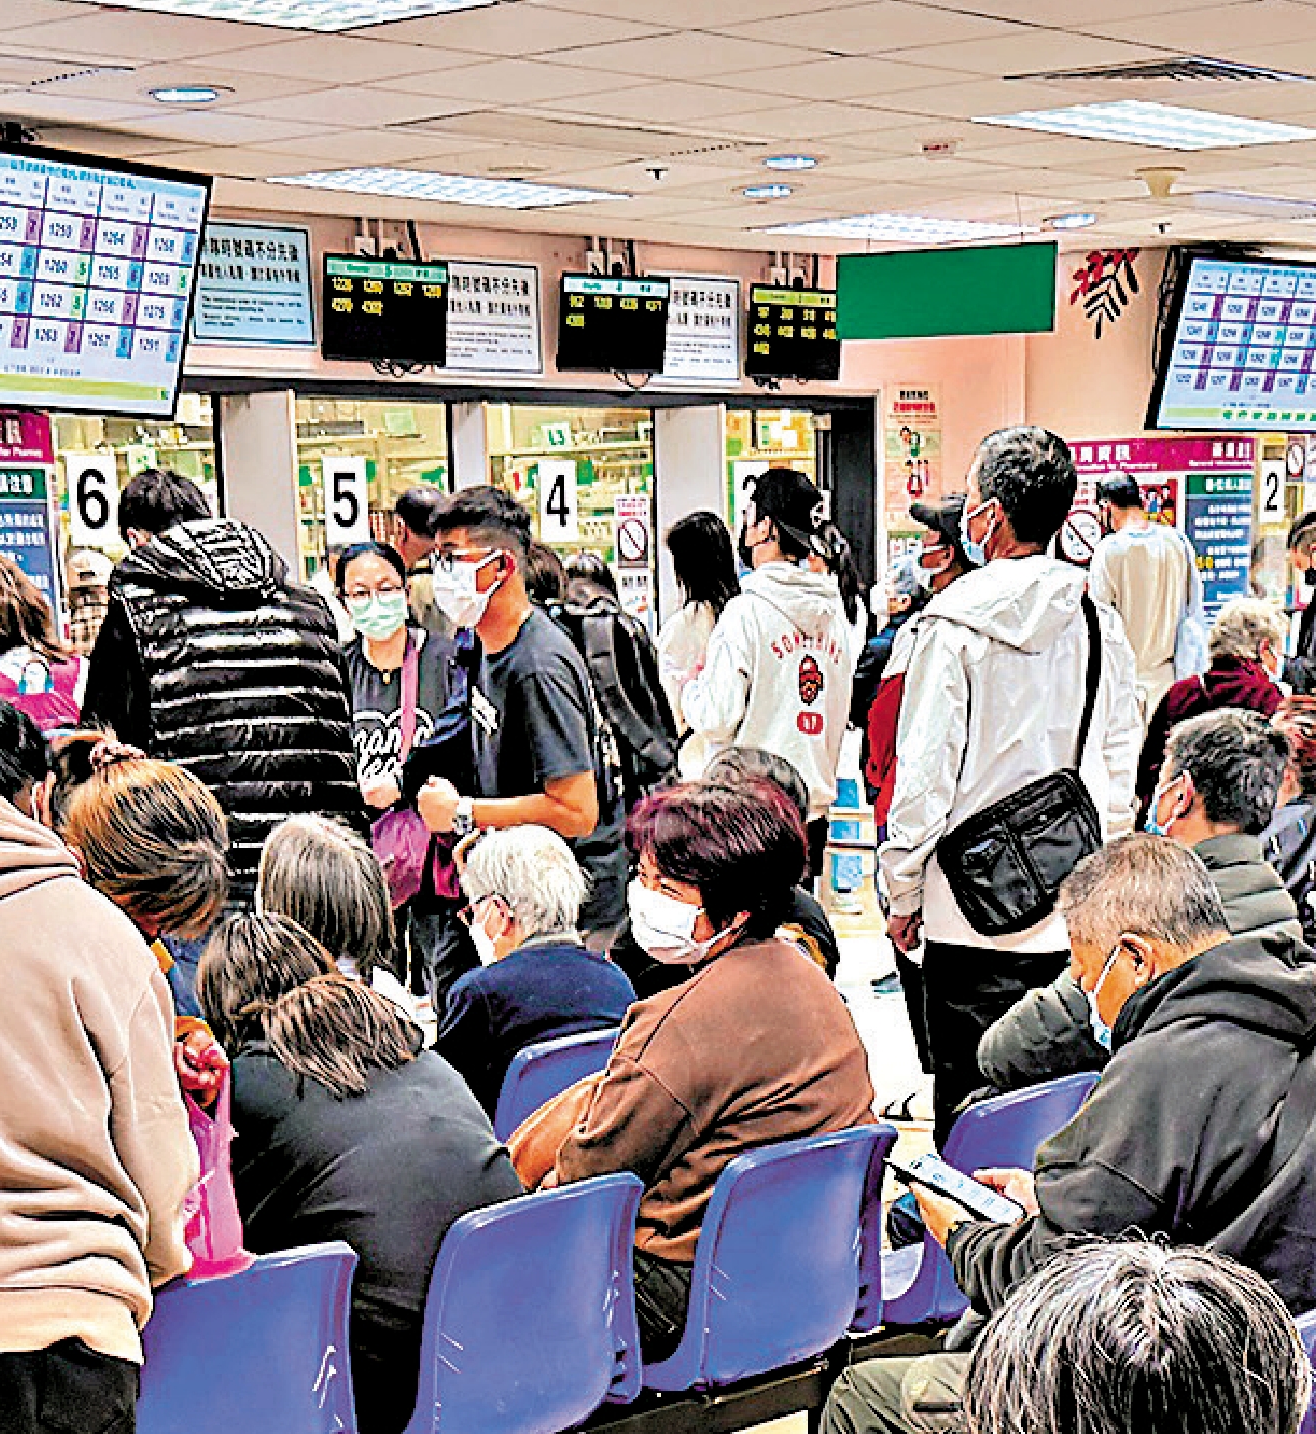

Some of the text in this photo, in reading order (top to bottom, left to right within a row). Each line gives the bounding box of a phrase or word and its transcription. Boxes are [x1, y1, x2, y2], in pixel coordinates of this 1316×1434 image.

[76, 468, 110, 530] 6
[333, 472, 359, 528] 5
[546, 474, 571, 528] 4
[1264, 472, 1280, 512] 2
